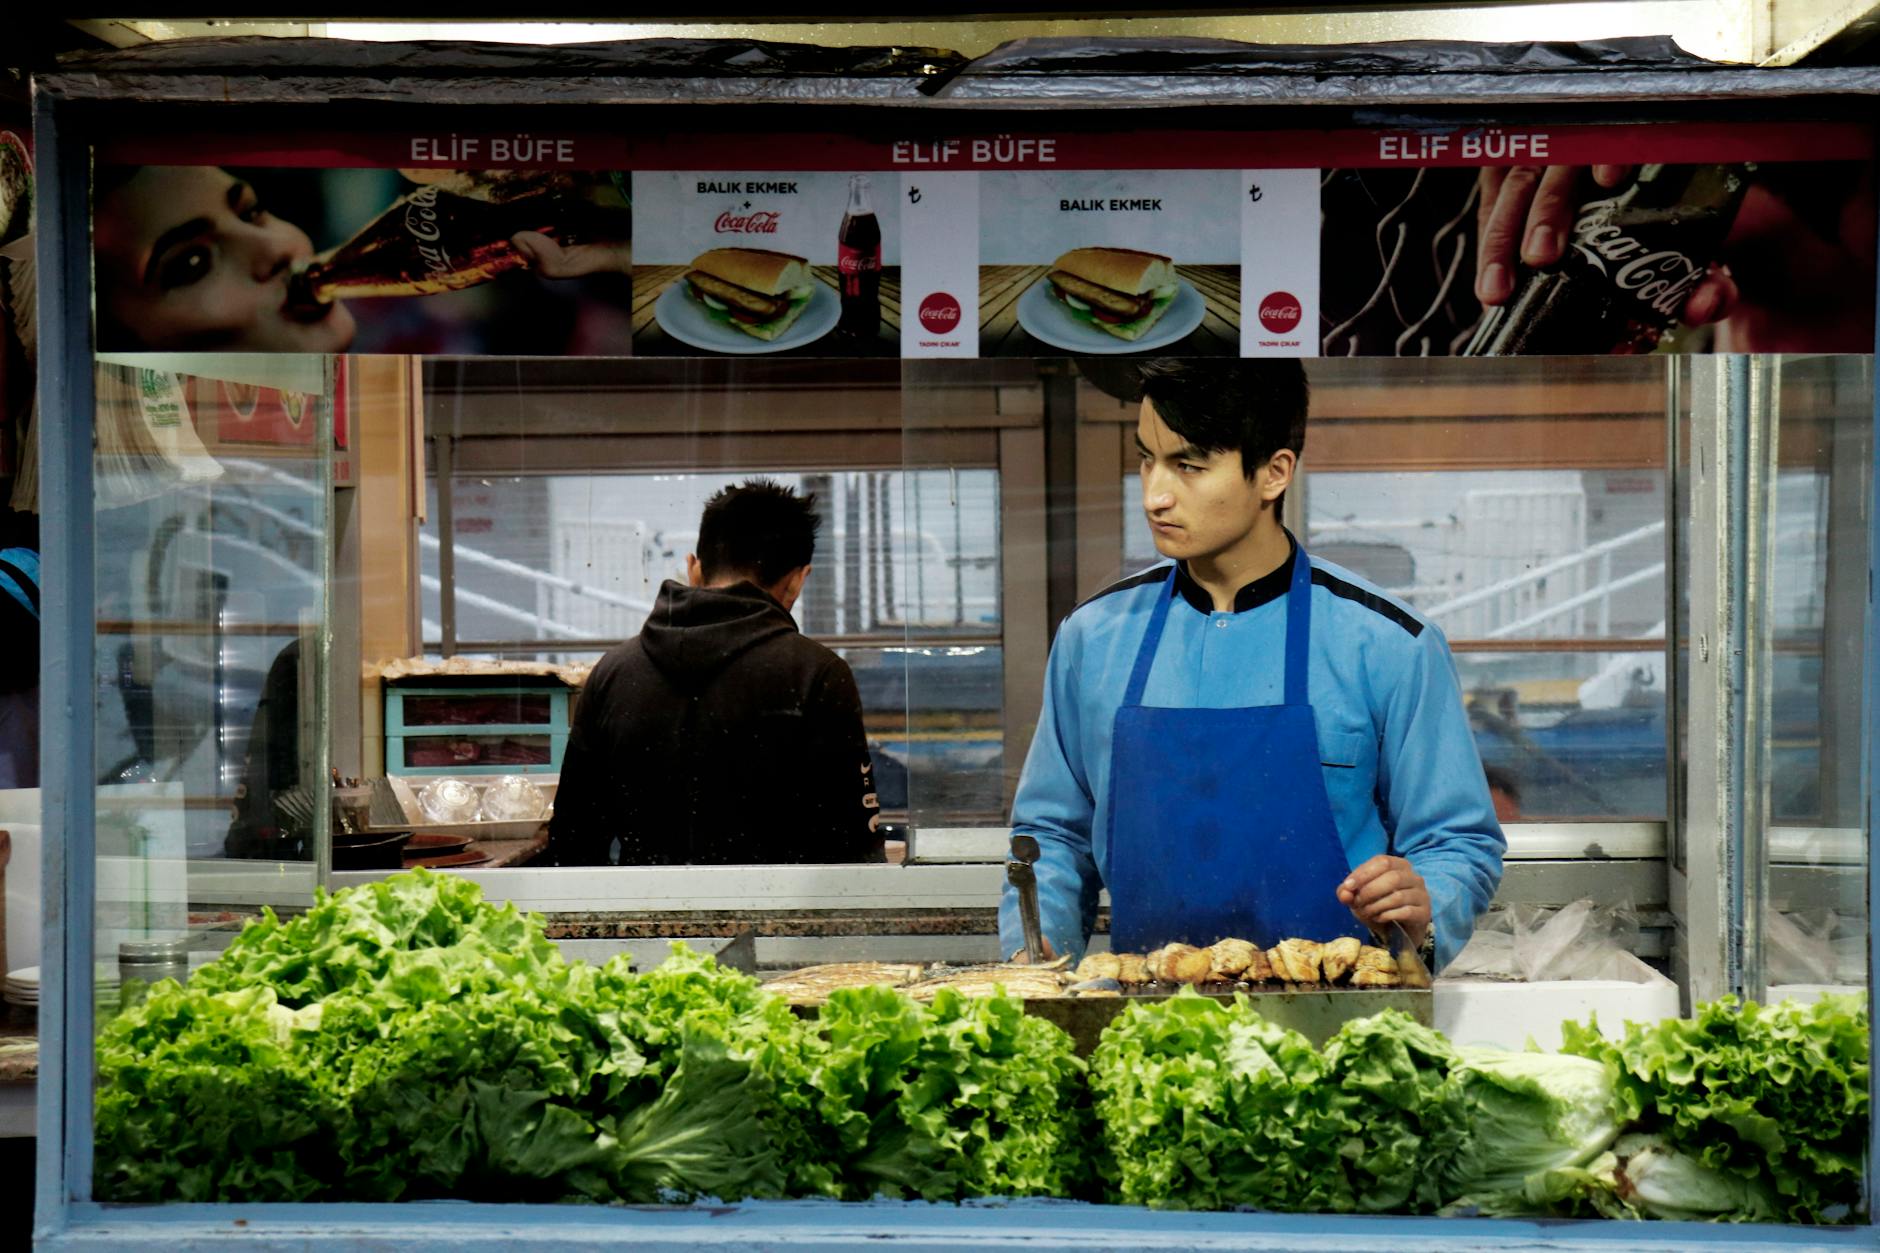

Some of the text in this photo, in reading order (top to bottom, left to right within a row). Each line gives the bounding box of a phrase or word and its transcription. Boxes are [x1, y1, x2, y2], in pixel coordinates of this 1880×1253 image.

[410, 133, 575, 163] ELİF BÜFE
[972, 134, 1057, 163] BÜFE
[1461, 130, 1550, 159] BÜFE
[697, 181, 798, 194] BALIK EKMEK
[1060, 200, 1162, 211] BALIK EKMEK
[714, 211, 781, 234] Coca-Cola
[919, 306, 957, 320] Coca-Cola
[1260, 306, 1299, 319] Coca-Cola
